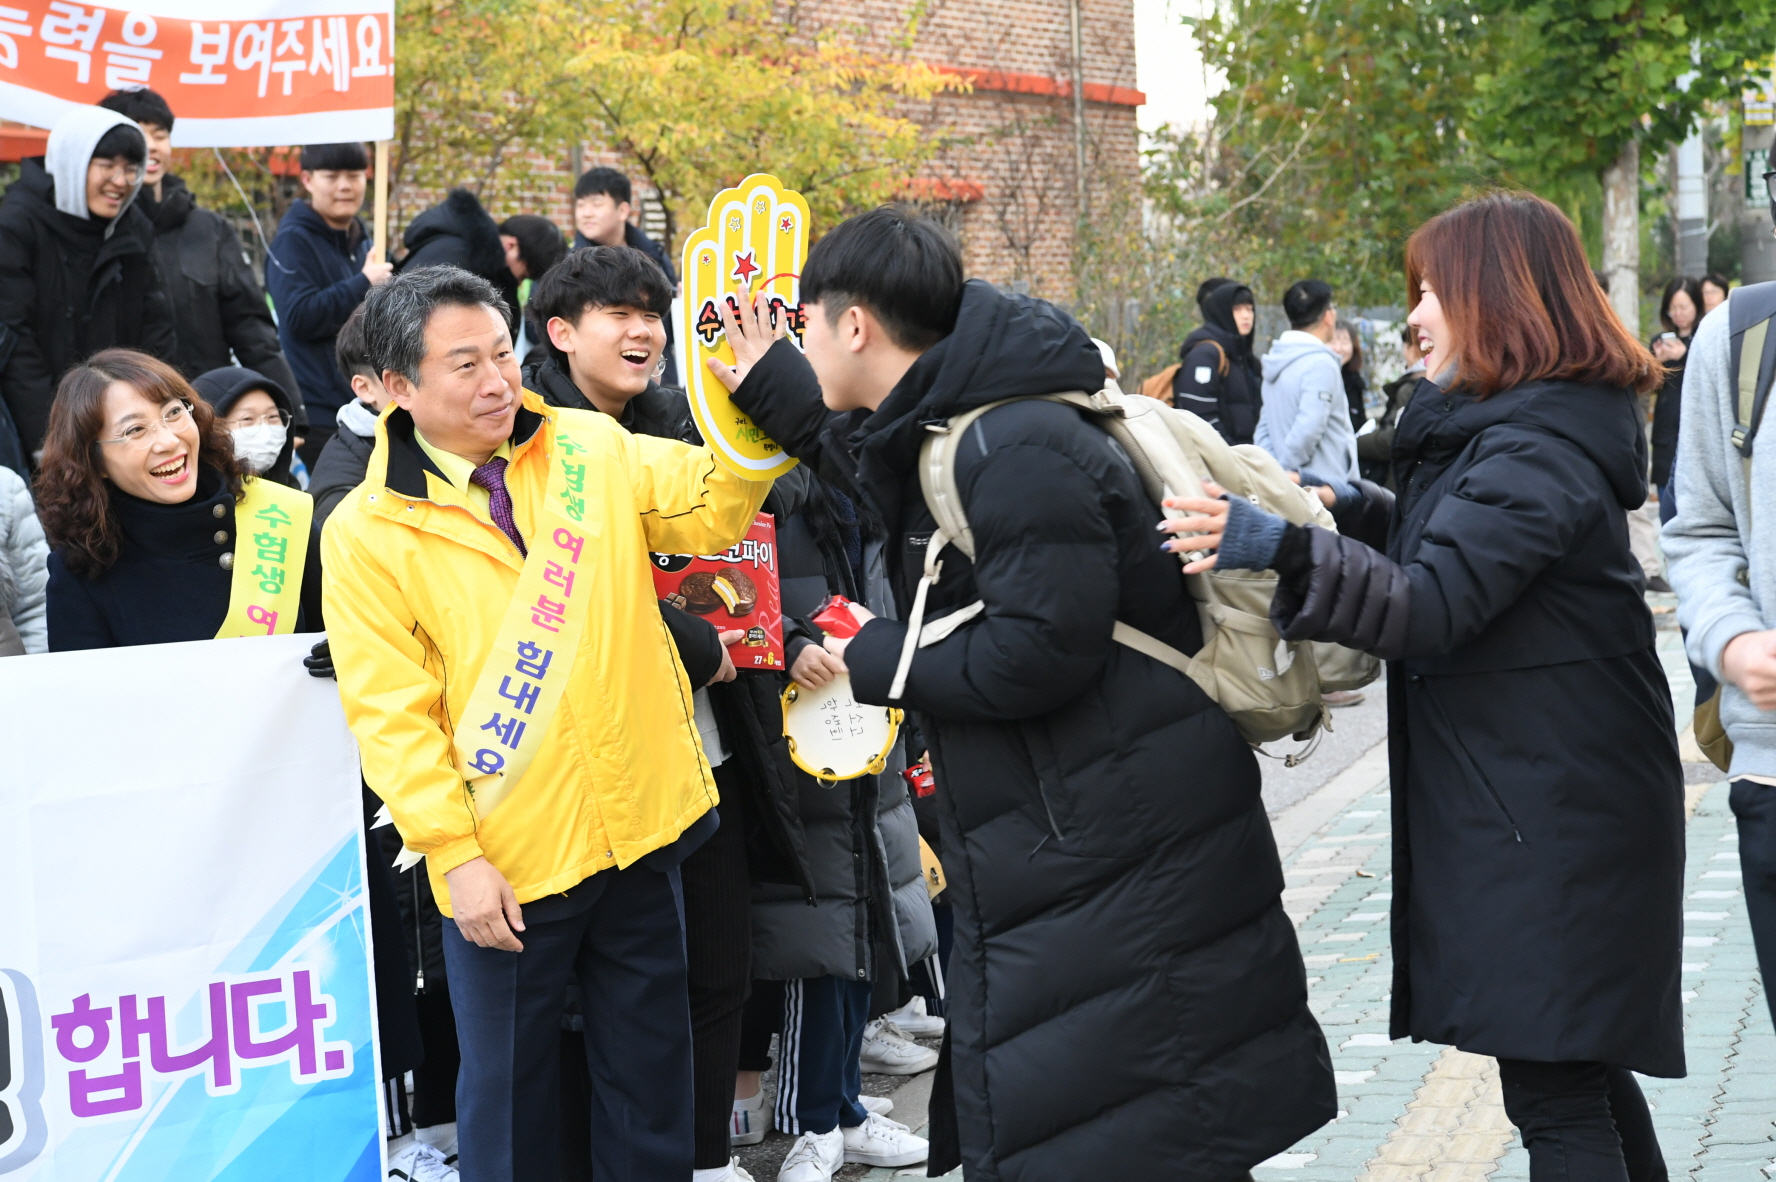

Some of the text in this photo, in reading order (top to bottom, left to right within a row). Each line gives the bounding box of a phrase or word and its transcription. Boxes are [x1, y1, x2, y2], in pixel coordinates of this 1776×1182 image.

[179, 15, 394, 98] 보여주세요!
[736, 426, 770, 443] 시민
[240, 504, 291, 637] 수험생 여
[531, 528, 584, 632] 여러분
[758, 560, 781, 648] Real
[820, 698, 843, 741] 학생회
[51, 970, 345, 1118] 합니다.
